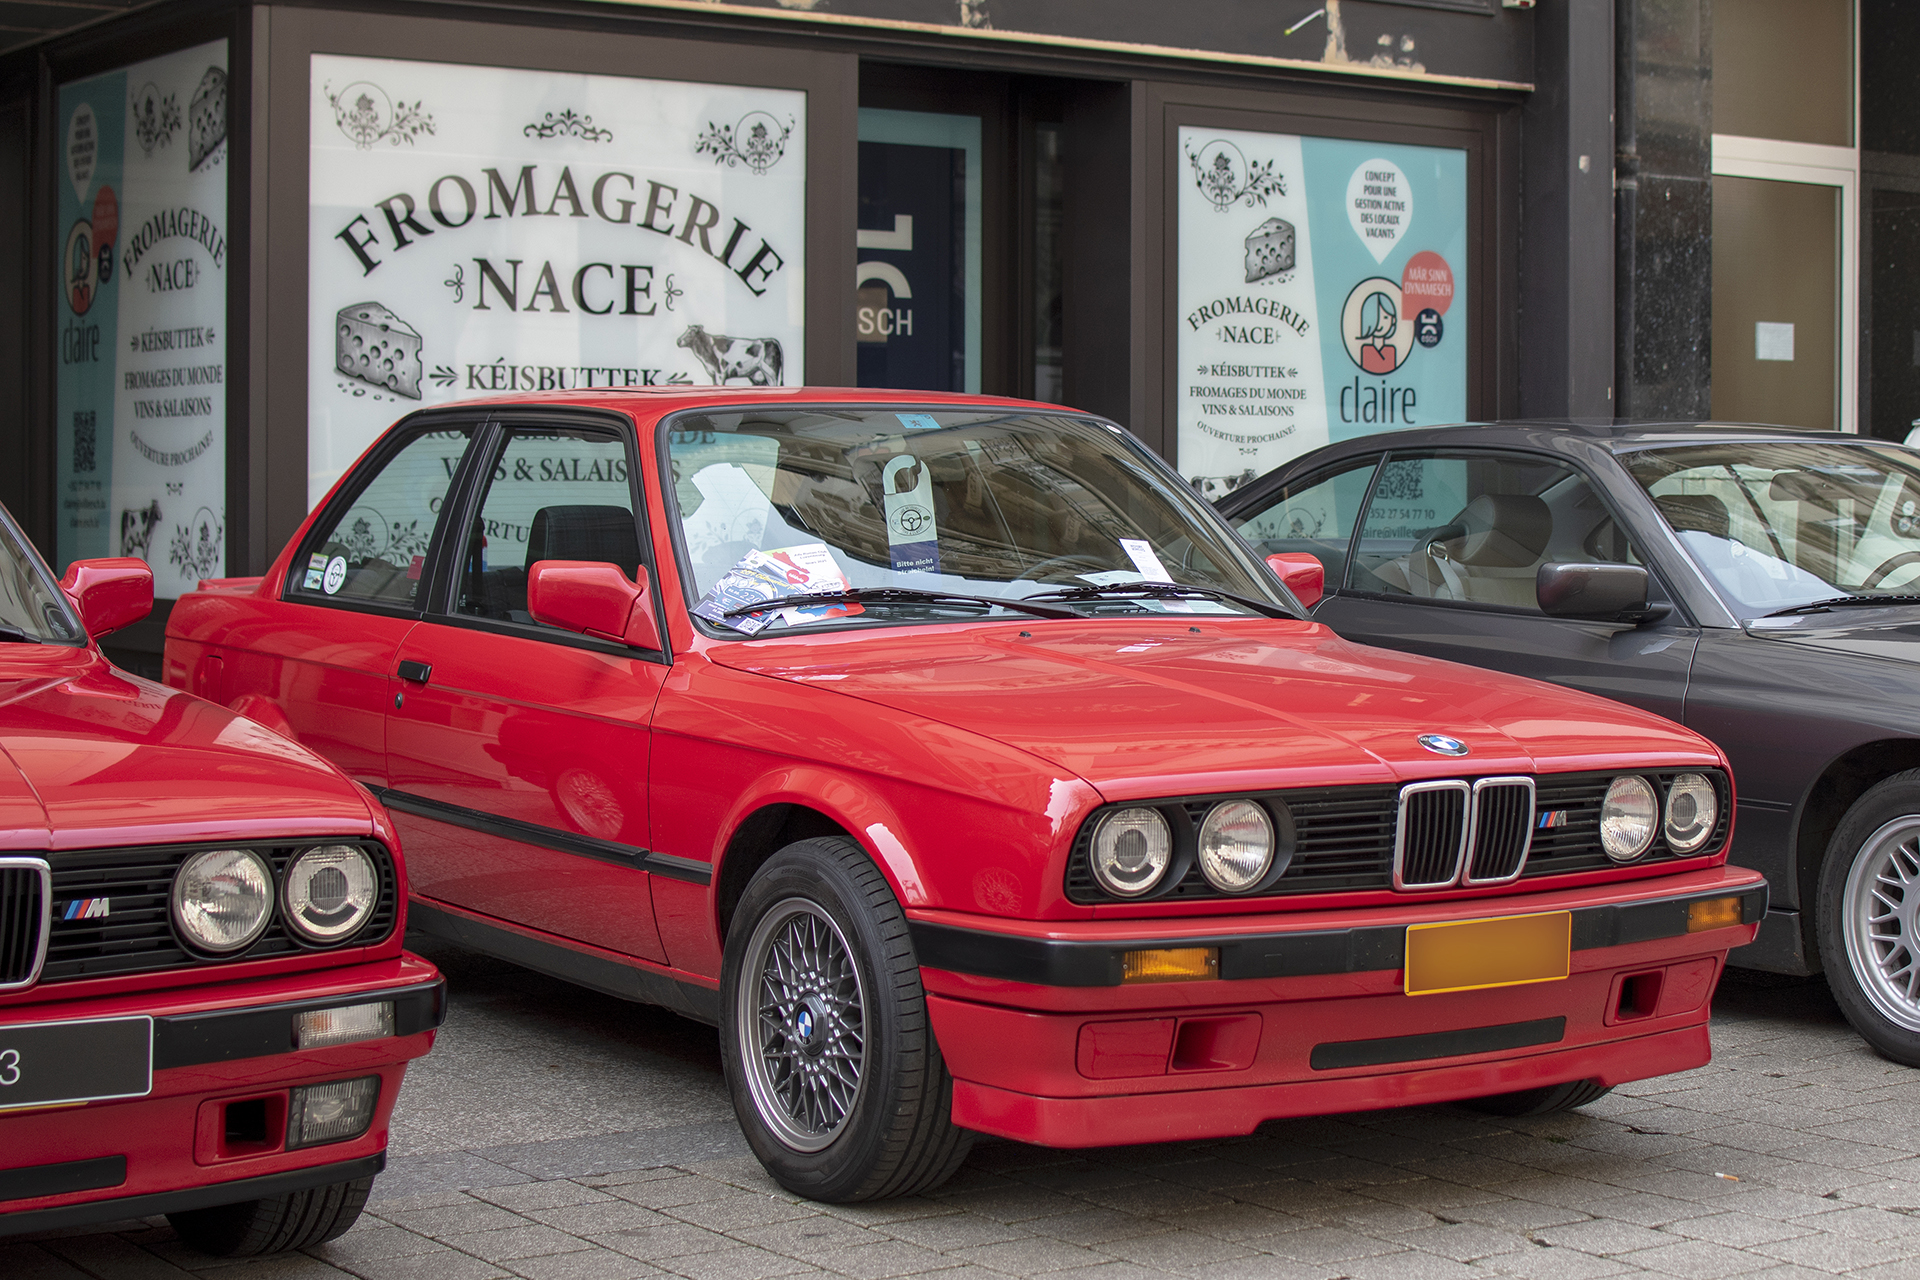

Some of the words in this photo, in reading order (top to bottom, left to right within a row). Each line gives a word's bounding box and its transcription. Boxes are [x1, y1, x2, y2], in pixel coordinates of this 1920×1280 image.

[1364, 170, 1396, 183] CONCEPT
[1363, 185, 1382, 196] POUR
[1383, 186, 1397, 197] UNE
[1354, 198, 1382, 210] GESTION
[1383, 200, 1406, 212] ACTIVE
[1360, 213, 1374, 224] DES
[1374, 214, 1400, 226] LOCAUX
[335, 165, 785, 298] FROMAGERIE
[1365, 227, 1396, 239] VACANTS
[122, 207, 227, 280] FROMAGERIE
[151, 257, 194, 293] NACE
[1408, 267, 1426, 282] MÄR
[1427, 269, 1447, 282] SINN
[472, 258, 658, 317] NACE
[1404, 281, 1452, 297] DYNAMESCH
[857, 307, 913, 336] SCH
[1186, 296, 1311, 338] FROMAGERIE
[62, 319, 100, 365] claire
[141, 326, 205, 353] KÉISBUTTEK
[1222, 326, 1275, 345] NACE
[124, 368, 172, 391] FROMAGES
[172, 367, 187, 387] DU
[187, 364, 223, 386] MONDE
[465, 357, 662, 391] KÉISBUTTEK
[1210, 361, 1286, 379] KÉISBUTTEK
[1189, 386, 1248, 399] FROMAGES
[1249, 387, 1267, 400] DU
[1267, 387, 1307, 401] MONDE
[1339, 375, 1417, 425] claire
[133, 399, 155, 420] VINS
[155, 400, 163, 418] &
[163, 397, 213, 418] SALAISONS
[1202, 403, 1228, 416] VINS
[1228, 404, 1237, 416] &
[1238, 404, 1295, 417] SALAISONS
[1196, 420, 1246, 444] OUVERTURE
[1246, 424, 1297, 444] PROCHAINE!
[129, 430, 170, 467] OUVERTURE
[513, 457, 535, 482] &
[1386, 508, 1398, 520] 27
[1399, 509, 1412, 521] 54
[1412, 509, 1424, 521] 77
[1424, 509, 1436, 521] 10
[896, 560, 914, 568] Bitte
[915, 558, 934, 566] nicht
